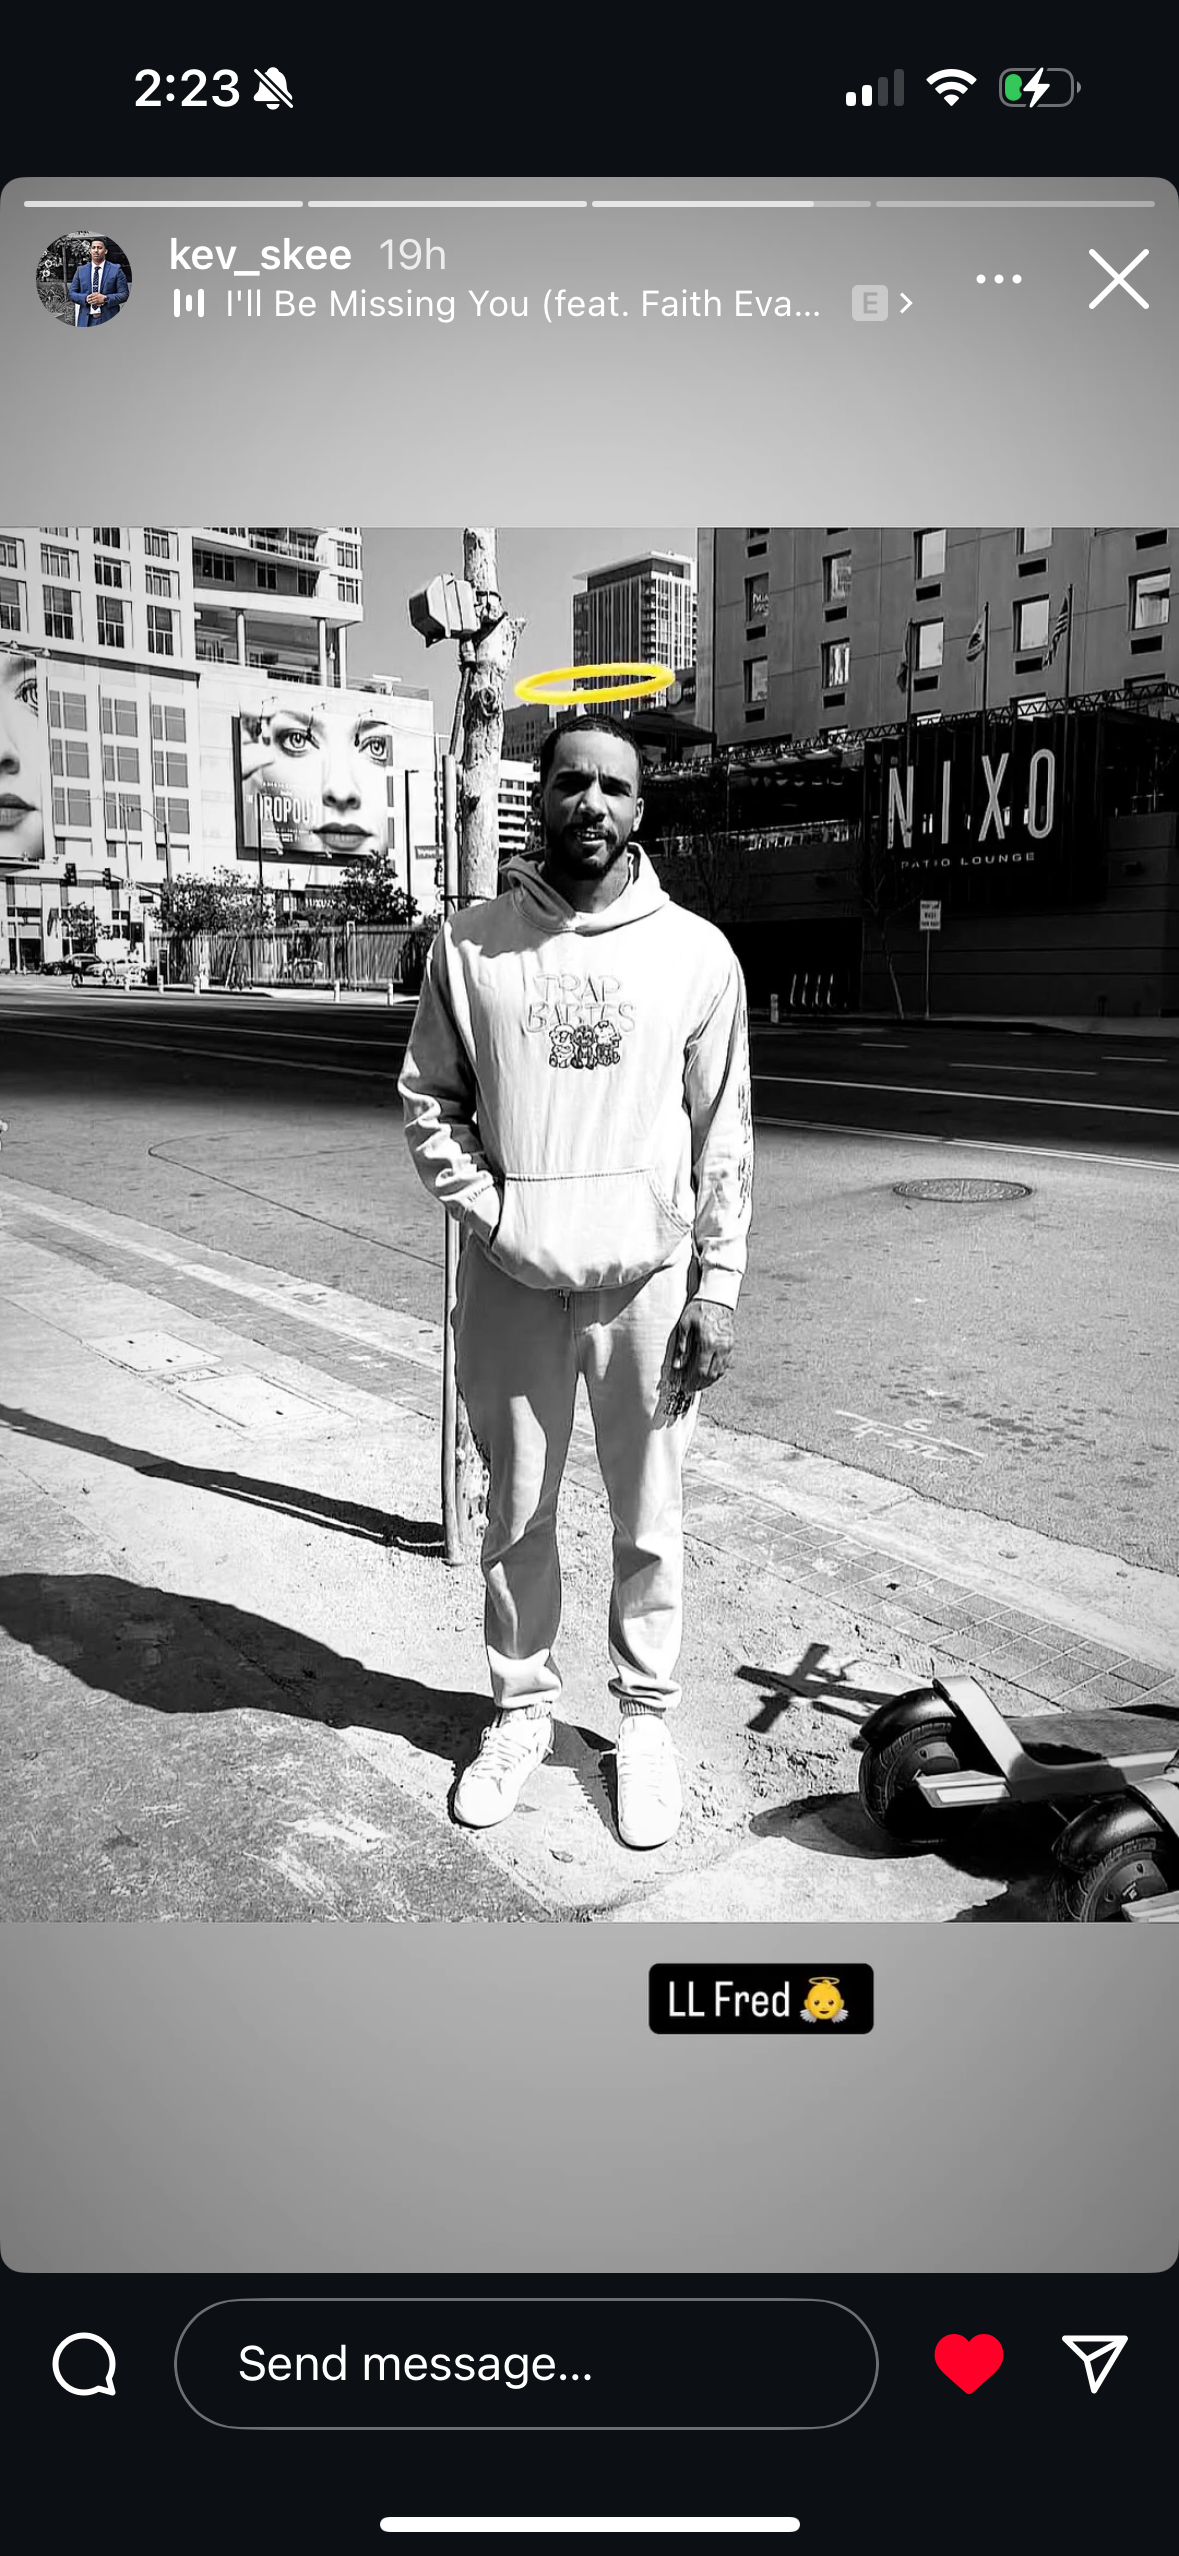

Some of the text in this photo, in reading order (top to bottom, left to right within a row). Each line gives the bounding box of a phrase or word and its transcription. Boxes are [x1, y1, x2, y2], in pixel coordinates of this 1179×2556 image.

[887, 748, 1056, 849] NIXO
[901, 852, 1035, 869] PATIO LOUNGE
[535, 973, 621, 1003] TRAP
